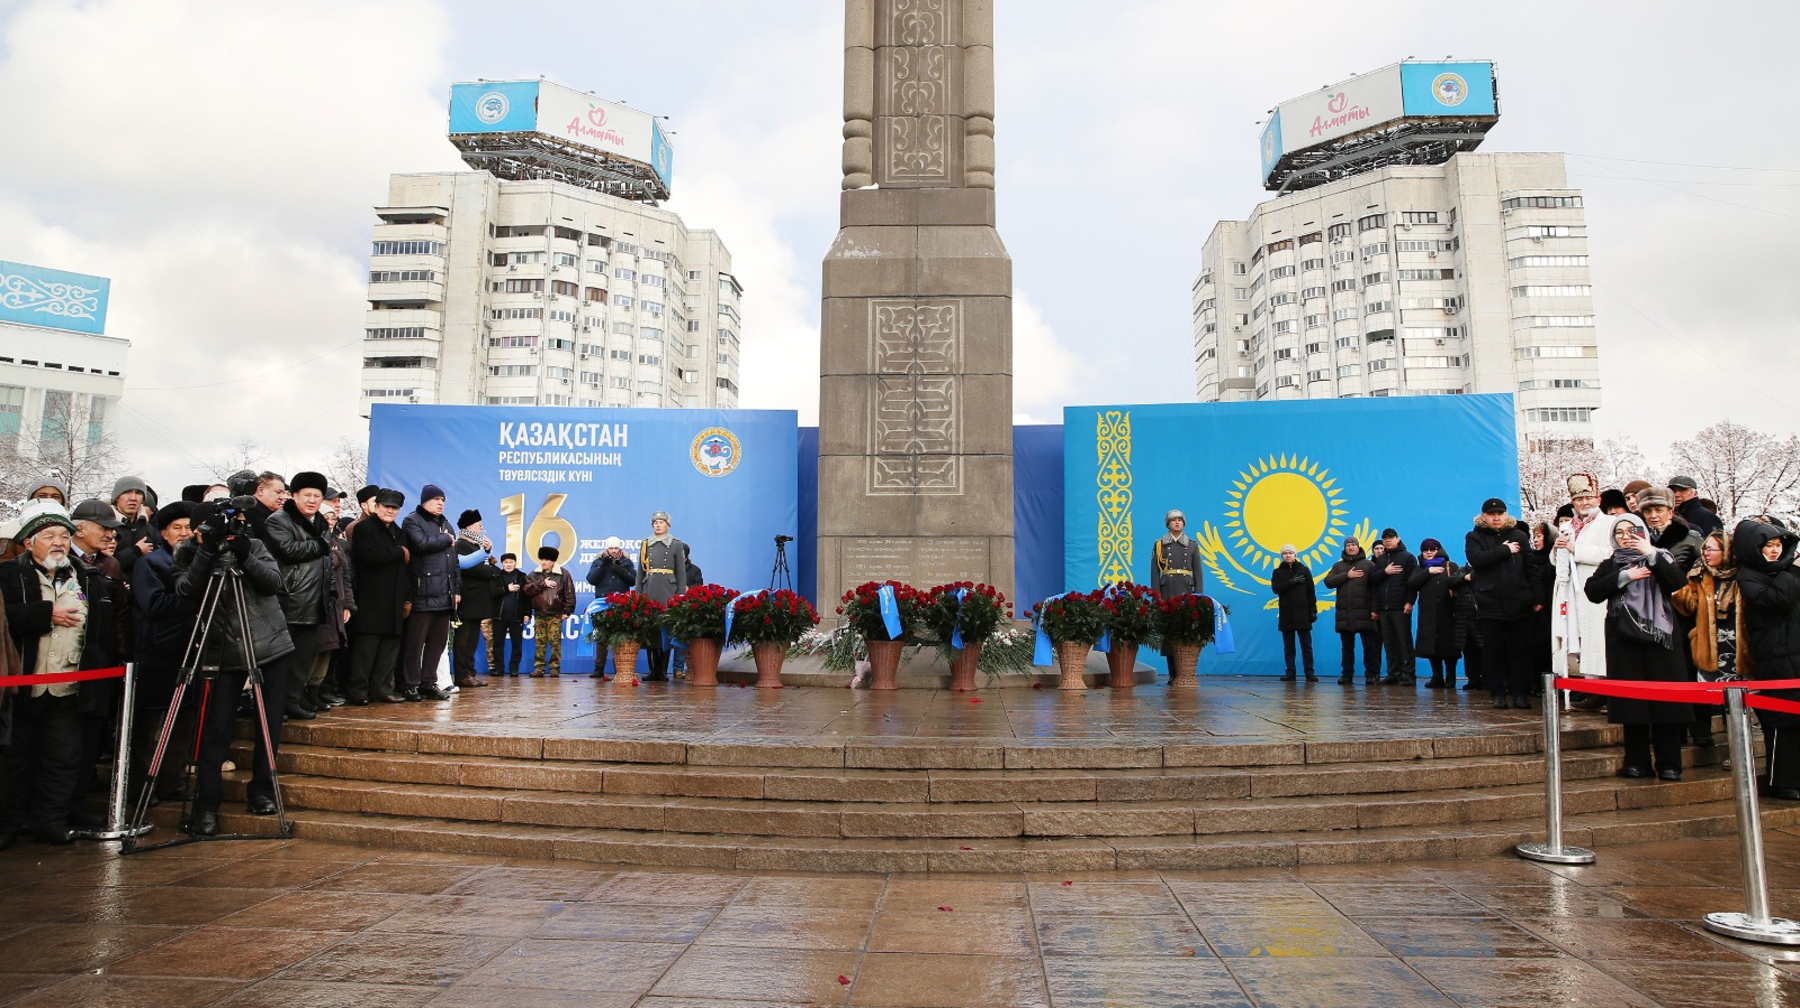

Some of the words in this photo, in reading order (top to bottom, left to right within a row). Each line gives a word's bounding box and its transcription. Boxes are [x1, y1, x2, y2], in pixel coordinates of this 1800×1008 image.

[567, 116, 625, 146] Алматы
[1309, 106, 1370, 138] Алматы
[499, 422, 628, 449] ҚАЗАҚСТАН
[499, 451, 621, 467] РЕСПУБЛИКАСЫНЫҢ
[568, 470, 592, 482] КҮНІ
[500, 493, 577, 568] 16
